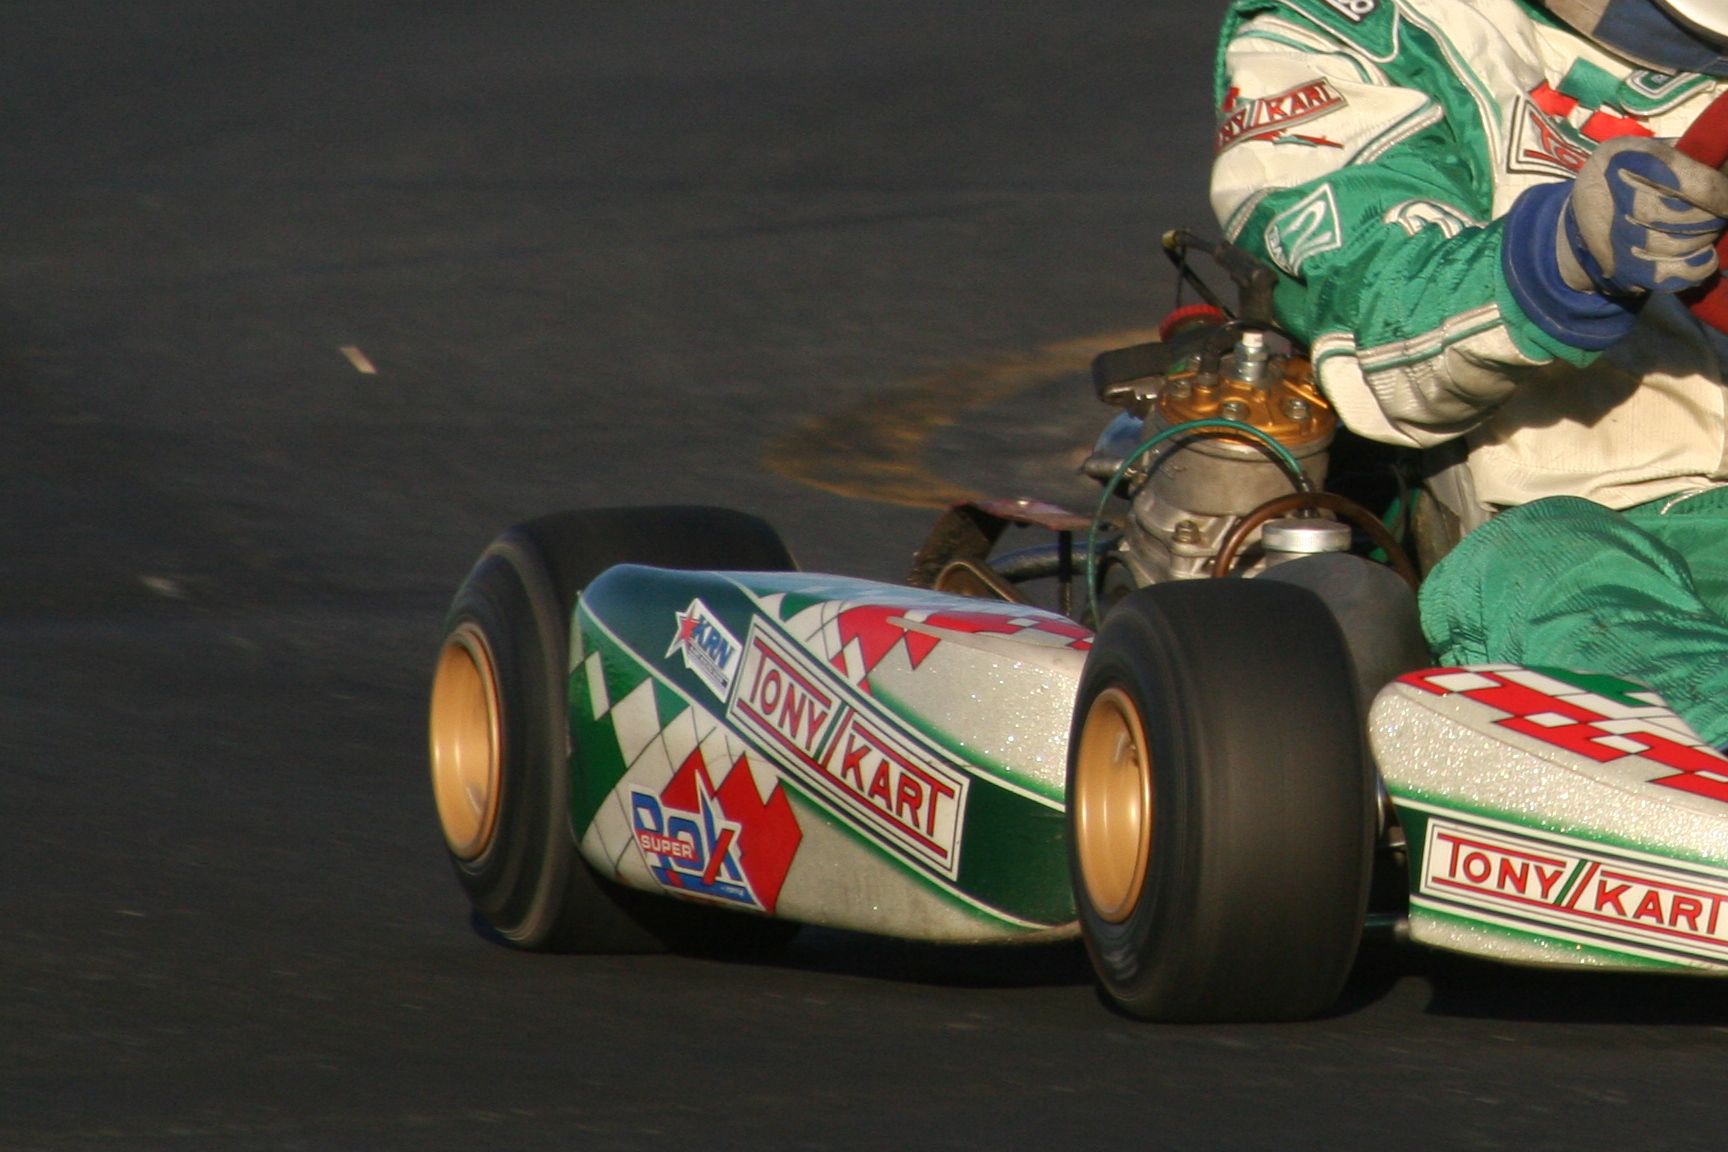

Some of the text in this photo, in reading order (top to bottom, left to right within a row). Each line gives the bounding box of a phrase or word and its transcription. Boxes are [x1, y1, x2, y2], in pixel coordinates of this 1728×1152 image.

[750, 636, 832, 752] TONY
[841, 720, 955, 837] KART
[640, 835, 693, 859] SUPER
[1437, 832, 1566, 899] TONY
